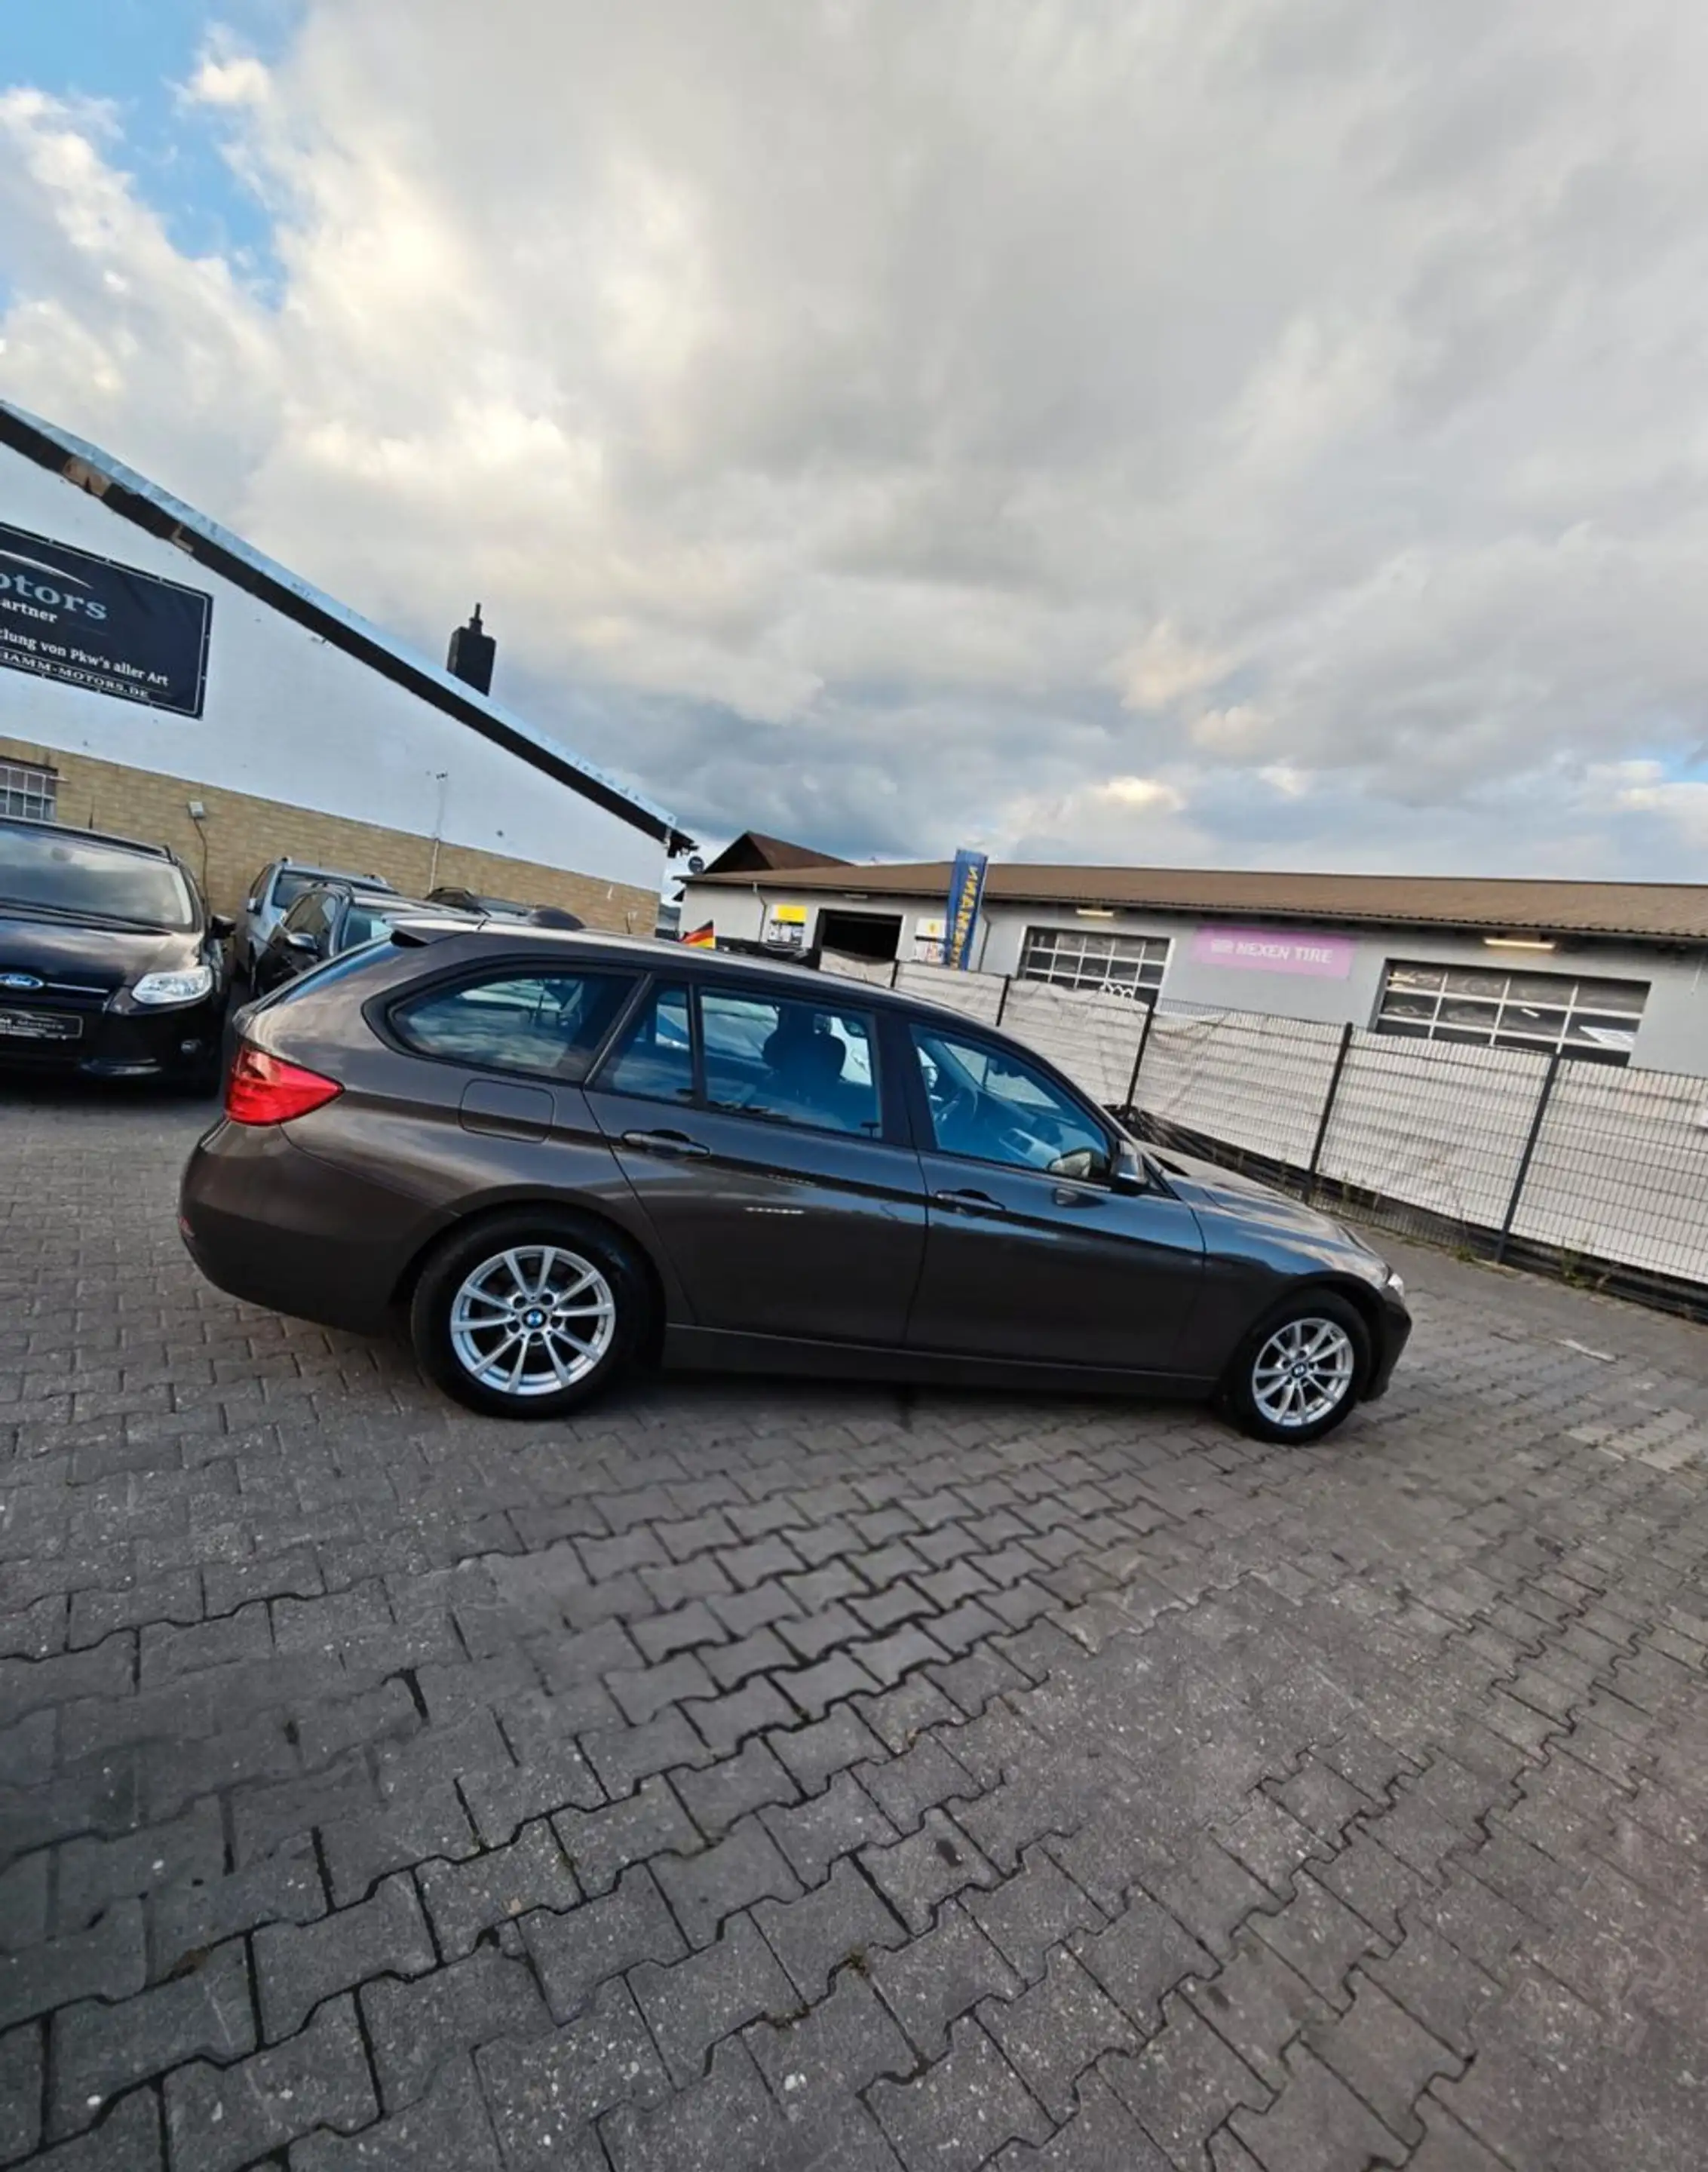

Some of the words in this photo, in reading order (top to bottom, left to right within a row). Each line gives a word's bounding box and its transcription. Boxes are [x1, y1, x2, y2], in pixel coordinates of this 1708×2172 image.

[0, 627, 37, 652] lung
[40, 641, 66, 657] von
[70, 646, 111, 669] Pkw's
[114, 661, 146, 680] aller
[147, 670, 170, 687] Art
[1235, 941, 1290, 960] NEXEN
[1295, 946, 1334, 964] TIRE
